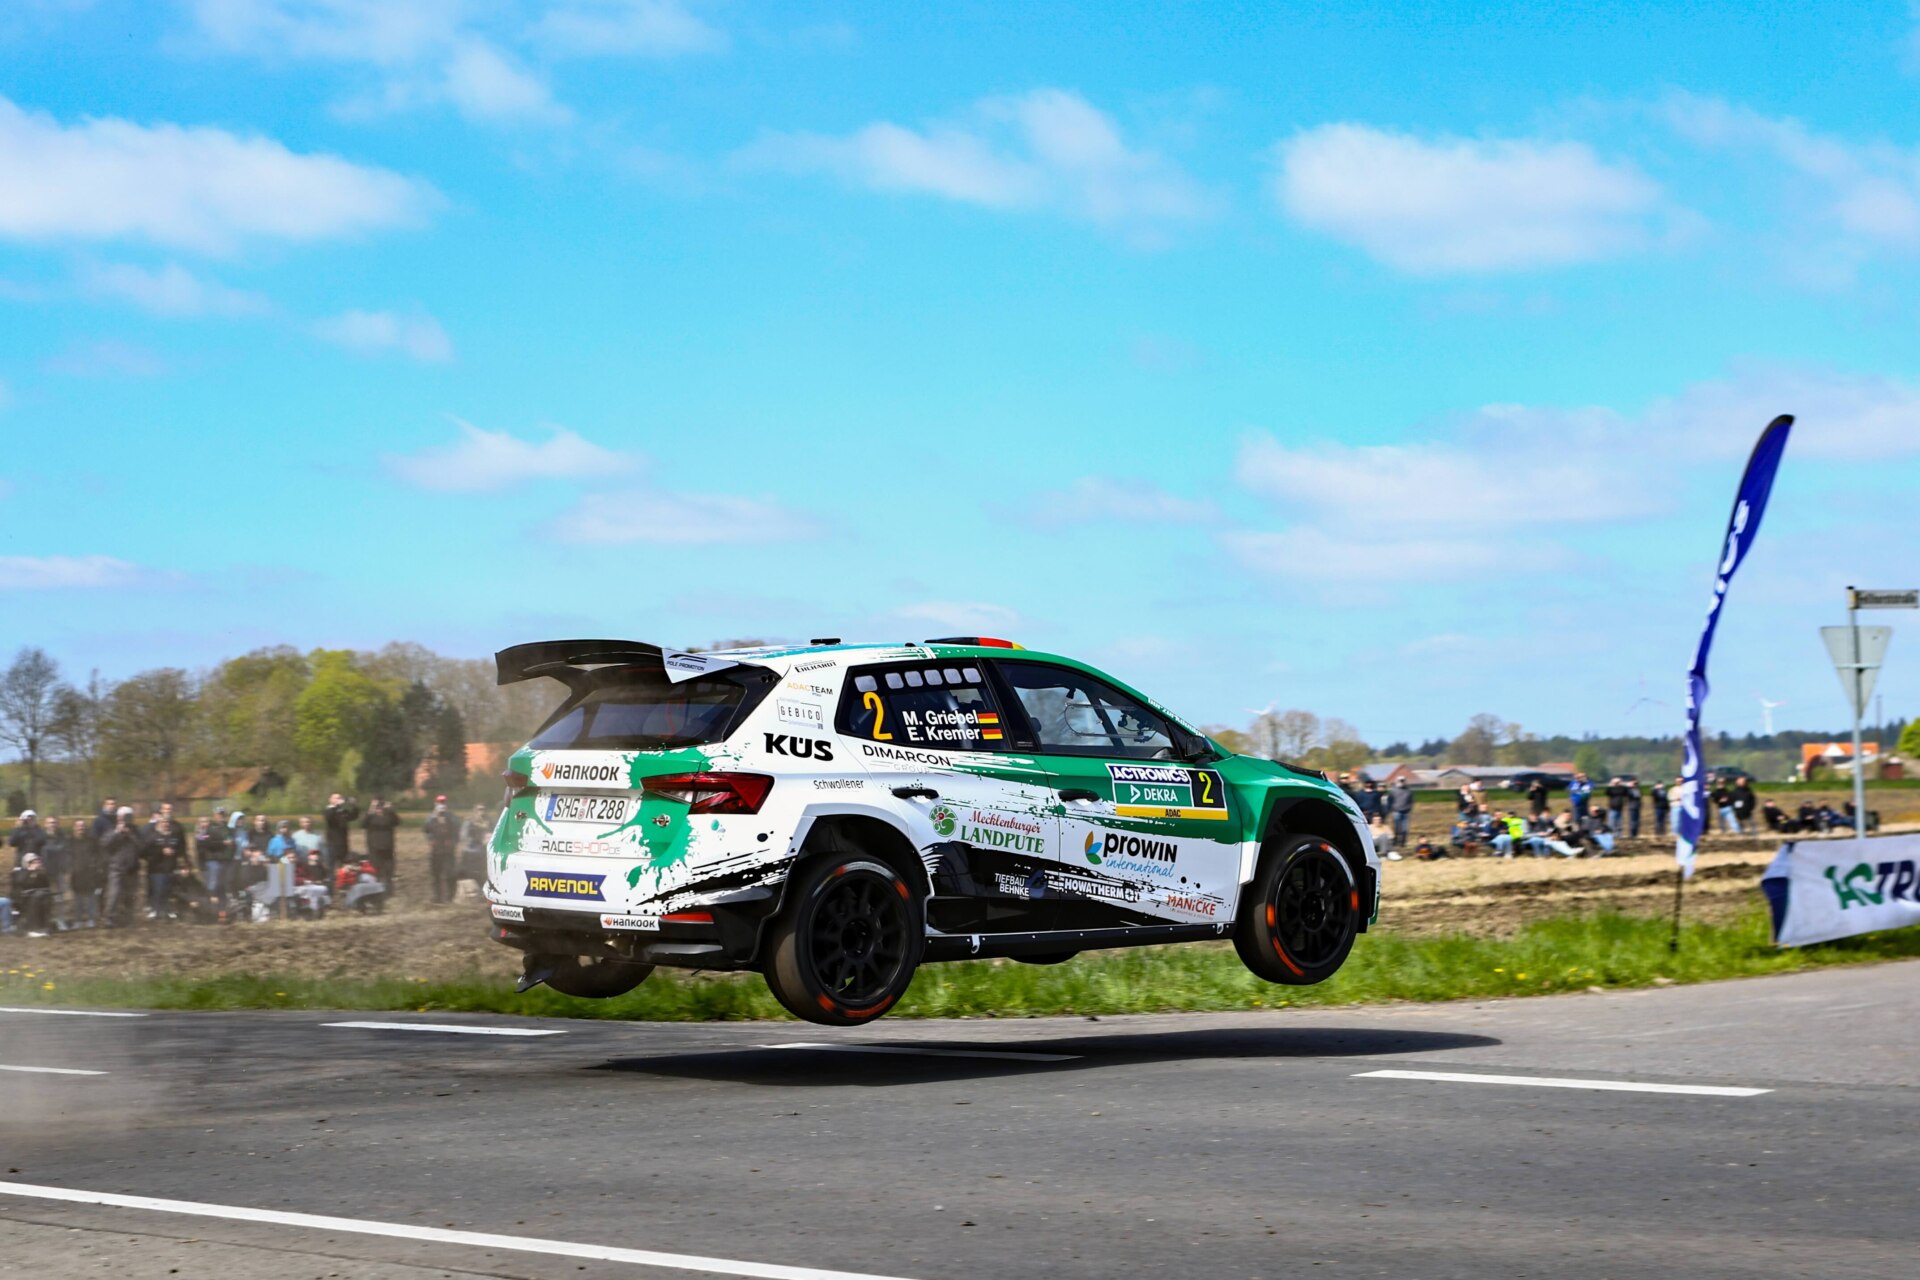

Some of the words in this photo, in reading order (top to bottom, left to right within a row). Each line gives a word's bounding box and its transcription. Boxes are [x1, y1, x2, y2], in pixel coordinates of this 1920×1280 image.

[780, 705, 821, 721] GEBICO
[863, 691, 893, 740] 2
[902, 710, 923, 726] M.
[925, 709, 978, 725] Griebel
[907, 727, 924, 741] E.
[925, 727, 980, 741] Kremer
[763, 732, 834, 762] KÜS
[862, 744, 951, 767] DIMARCON
[1112, 766, 1189, 782] ACTRONICS
[1143, 788, 1178, 802] DEKRA
[1198, 771, 1215, 804] 2
[553, 798, 581, 818] SHG
[585, 799, 597, 819] R
[596, 799, 625, 820] 288
[1164, 809, 1181, 818] ADAC
[969, 810, 1041, 834] Mecklenburger
[960, 825, 1045, 854] LANDPUTE
[1105, 854, 1175, 878] international
[529, 877, 599, 895] RAVENOL
[995, 873, 1025, 887] TIEFBAU
[1000, 883, 1030, 897] BEHNKE
[1064, 878, 1125, 899] HOWATHERM
[1824, 860, 1920, 910] ACTR
